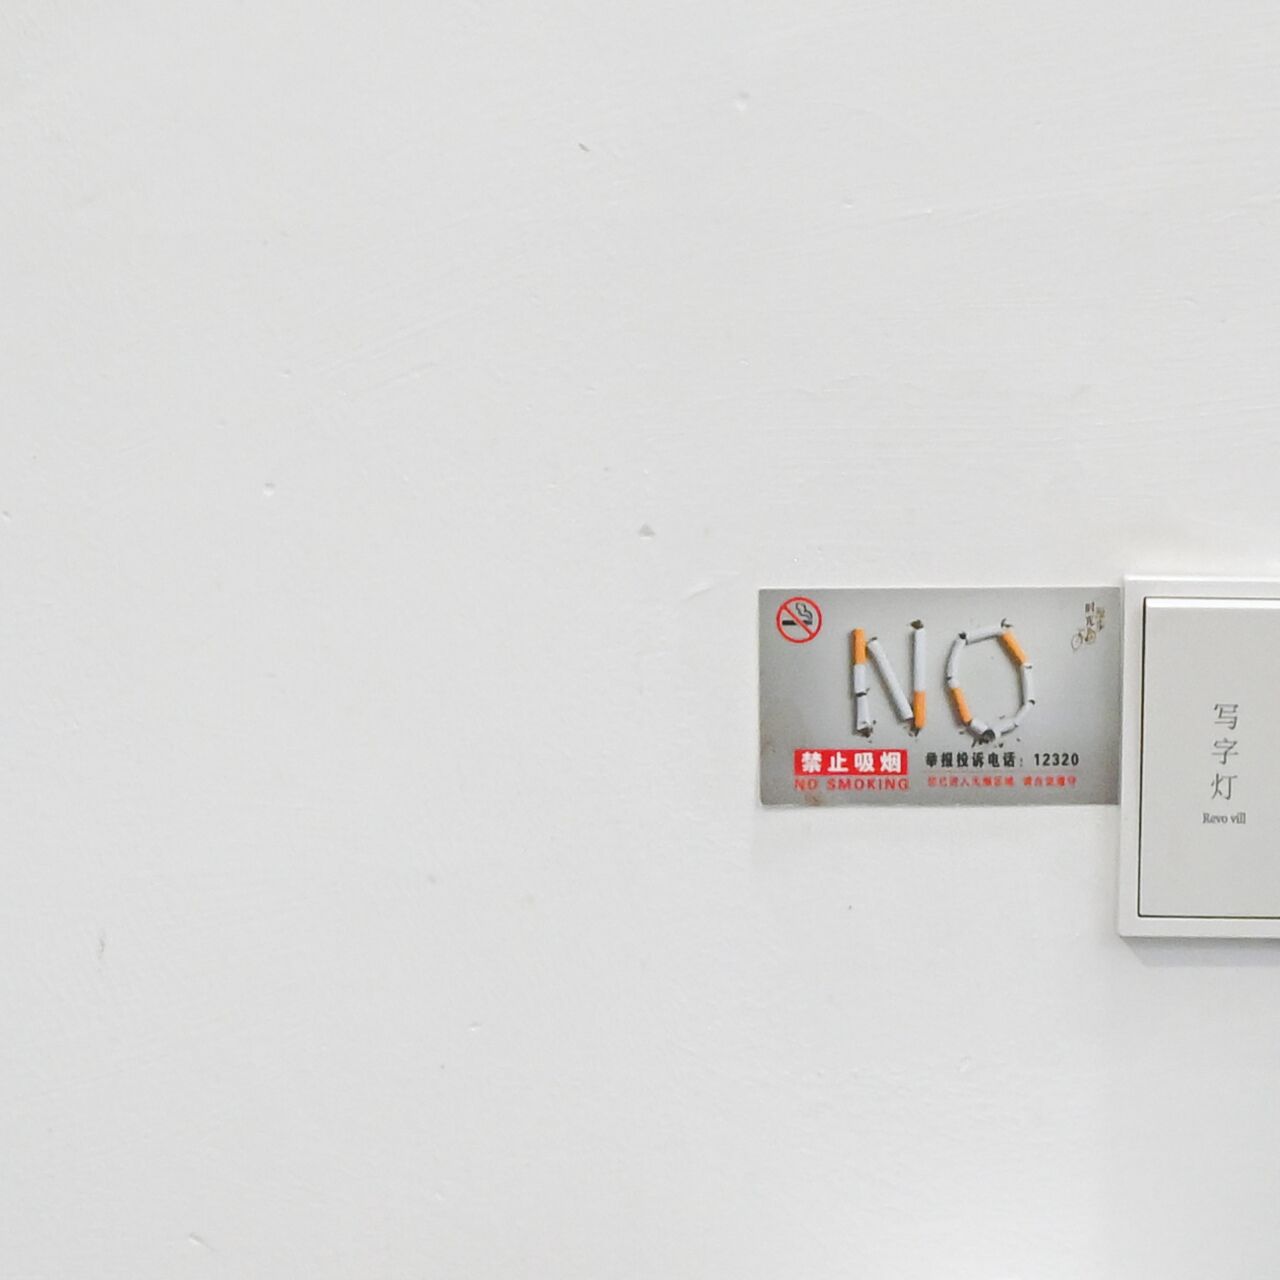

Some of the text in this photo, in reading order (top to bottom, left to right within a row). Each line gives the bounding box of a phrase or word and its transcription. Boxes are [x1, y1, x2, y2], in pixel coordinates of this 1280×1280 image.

[1034, 752, 1079, 766] 12320
[1210, 703, 1239, 801] 写字灯
[801, 751, 902, 773] 禁止吸烟
[795, 779, 909, 790] NO SMOKING
